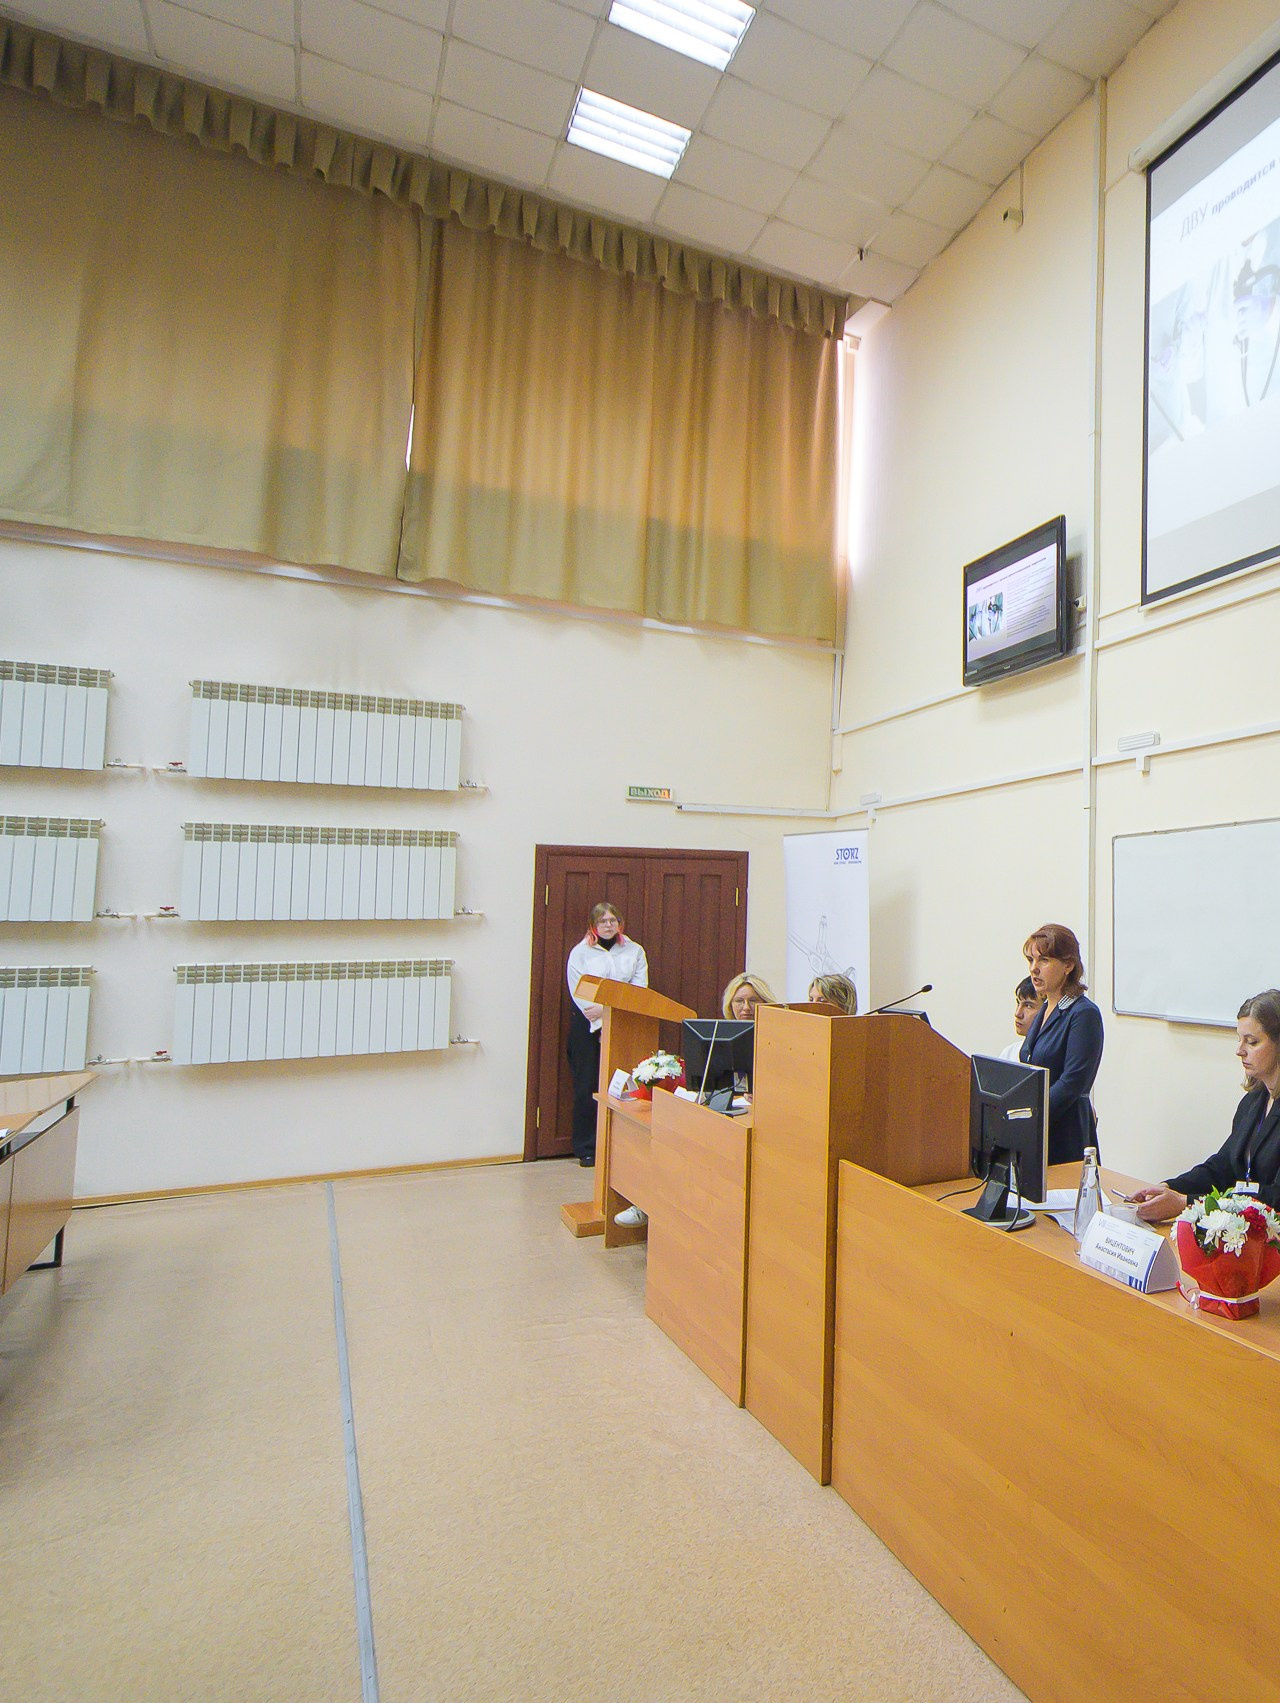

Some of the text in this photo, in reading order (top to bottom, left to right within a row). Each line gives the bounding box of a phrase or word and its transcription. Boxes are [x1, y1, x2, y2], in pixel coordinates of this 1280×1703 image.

[1211, 157, 1275, 218] проводится
[630, 787, 669, 799] ВЫХОД
[836, 847, 859, 860] STORZ
